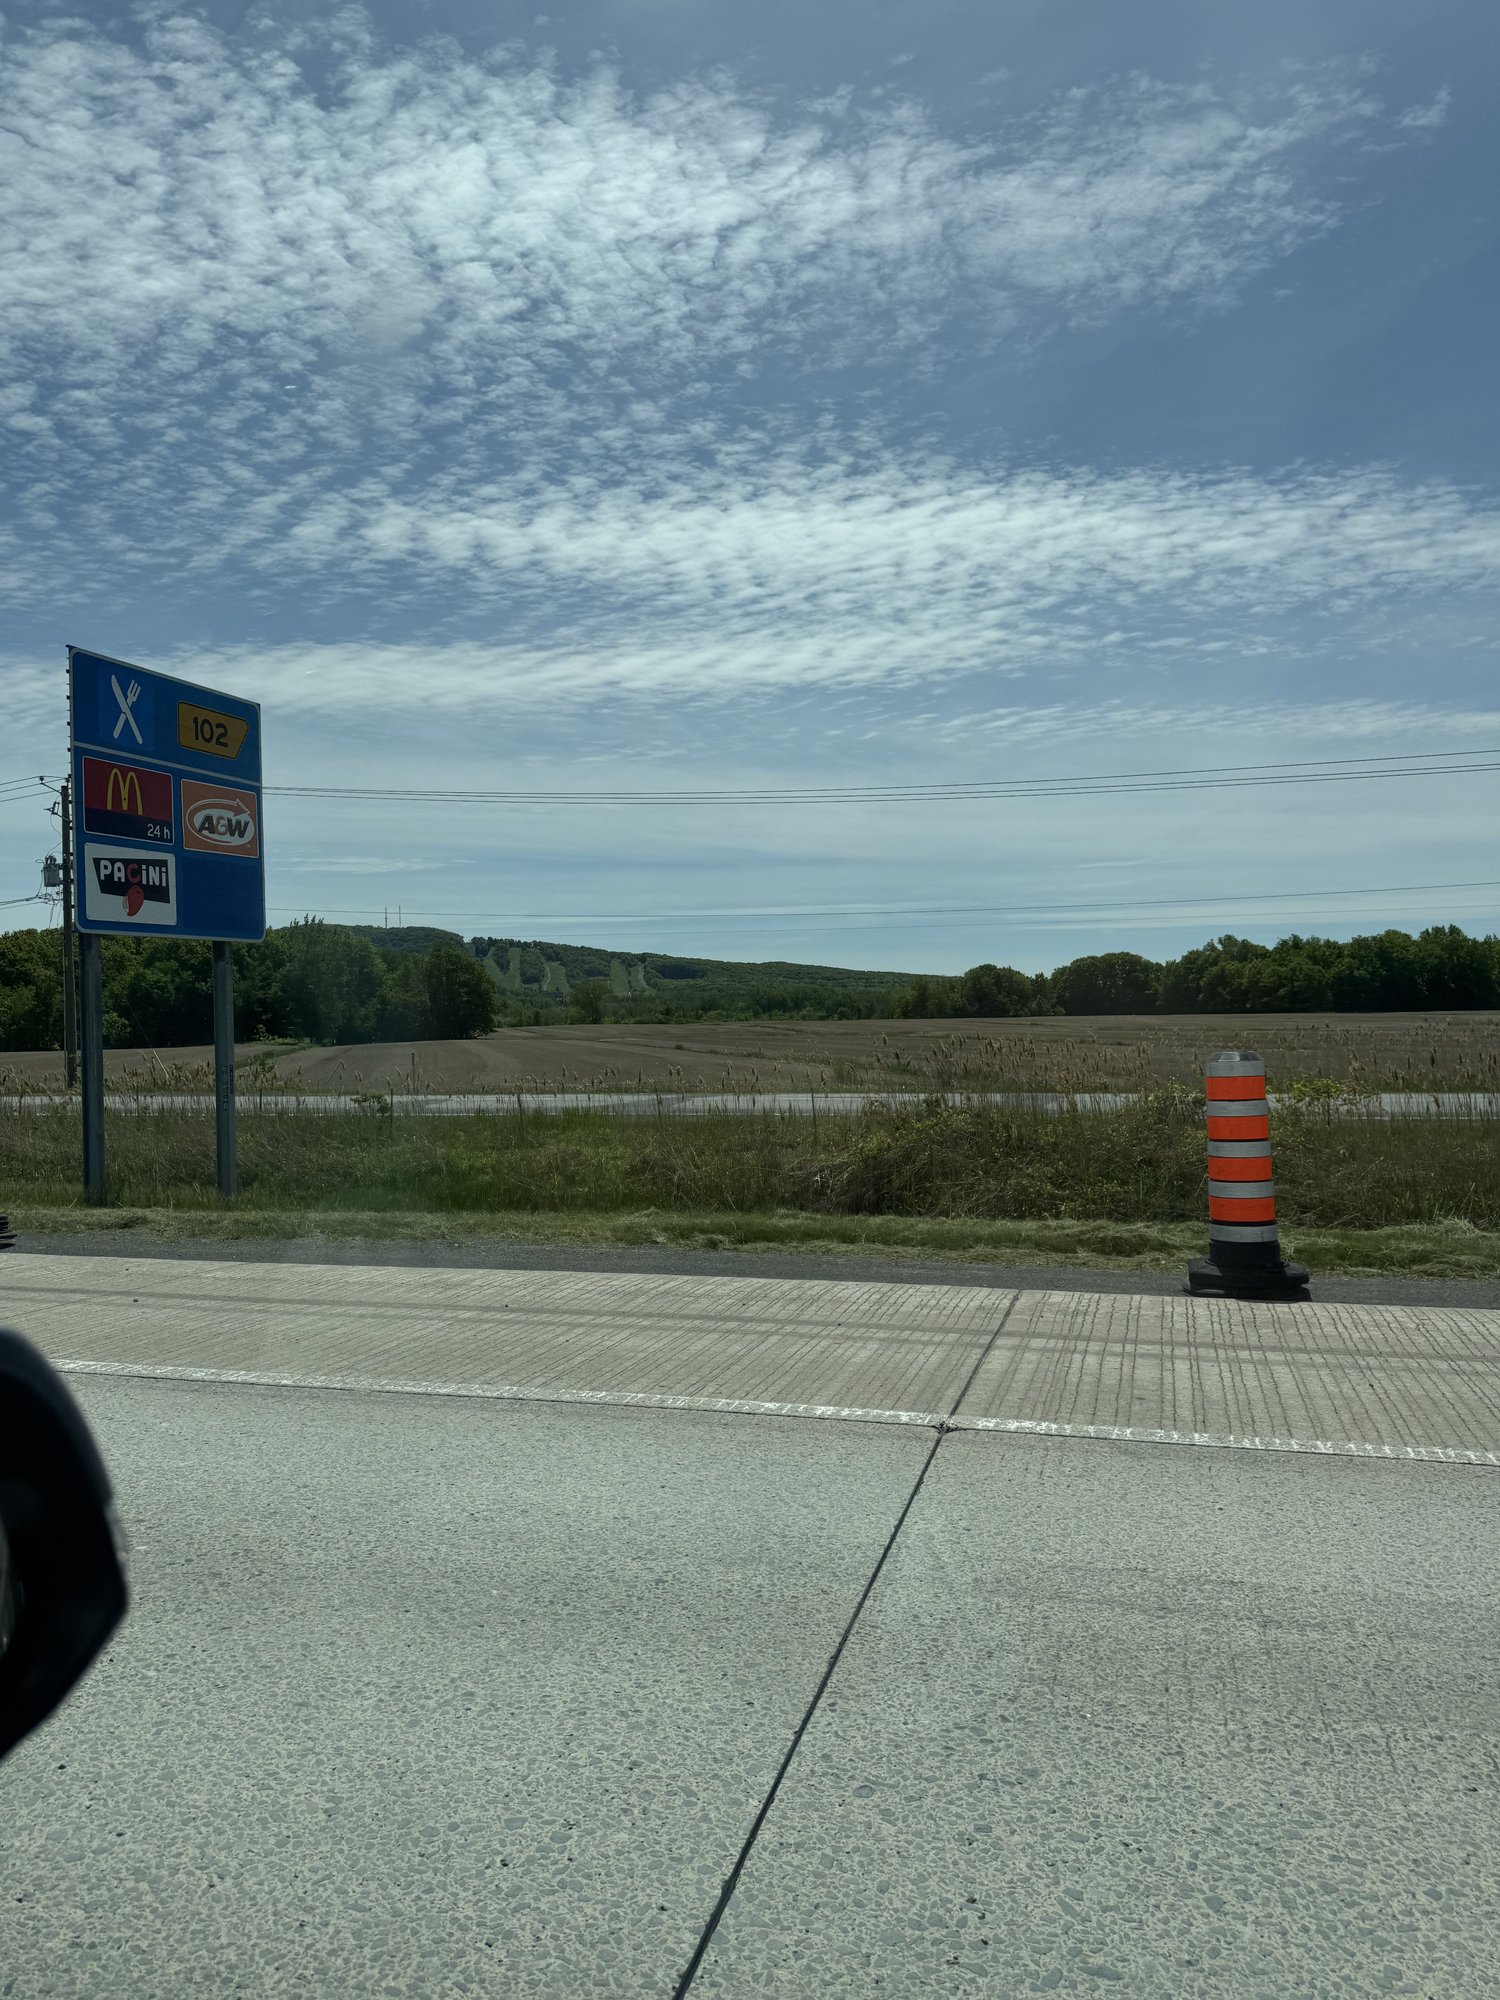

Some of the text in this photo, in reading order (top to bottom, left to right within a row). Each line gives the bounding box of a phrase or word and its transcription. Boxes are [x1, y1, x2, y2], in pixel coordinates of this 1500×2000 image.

[193, 716, 229, 748] 102
[147, 823, 171, 840] 24 h
[197, 815, 250, 839] A&W
